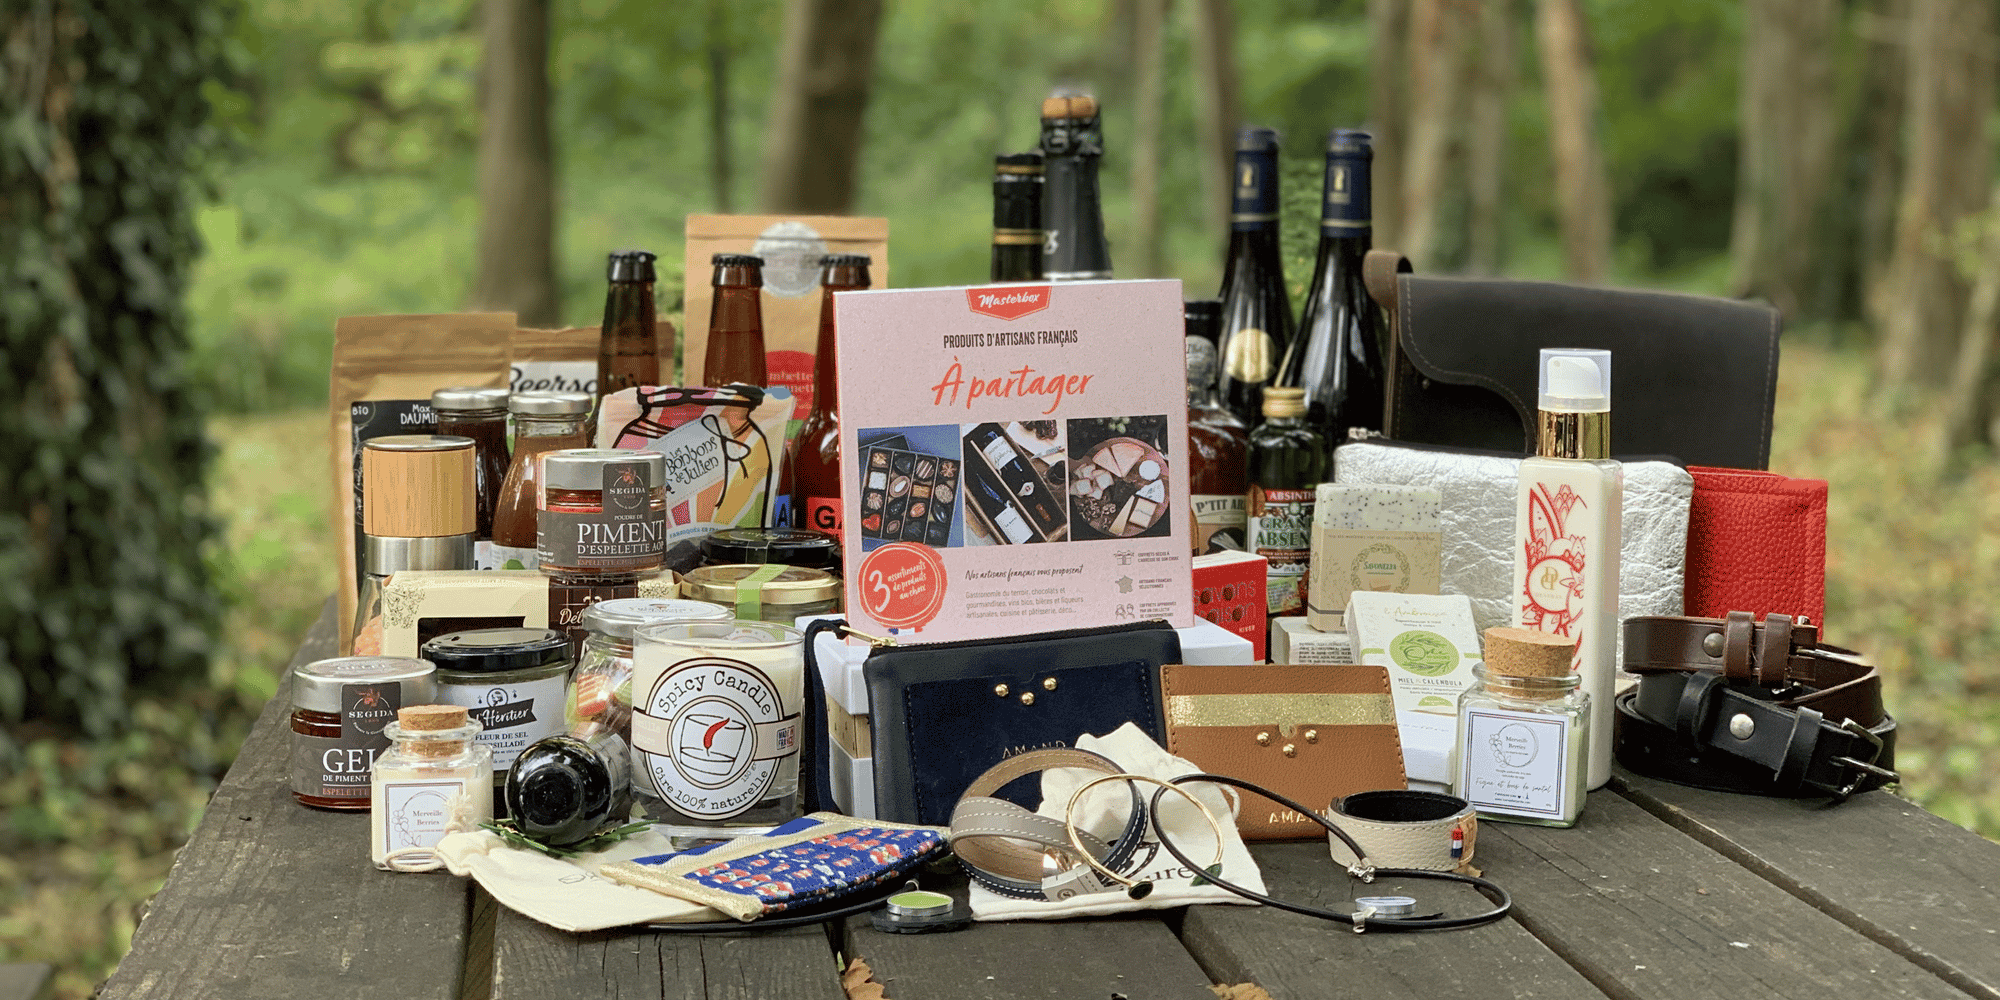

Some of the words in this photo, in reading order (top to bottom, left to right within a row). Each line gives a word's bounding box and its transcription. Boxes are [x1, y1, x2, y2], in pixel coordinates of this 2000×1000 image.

[977, 291, 1041, 309] Masterbox
[943, 333, 985, 349] PRODUITS
[987, 331, 1036, 347] D'ARTISANS
[1037, 329, 1078, 348] FRANÇAIS
[931, 355, 965, 406] À
[966, 364, 1094, 415] partager
[412, 404, 431, 413] Max
[666, 436, 719, 476] Bonbons
[674, 471, 684, 483] de
[682, 456, 719, 485] Julien
[609, 487, 646, 495] SEGIDA
[1195, 499, 1228, 513] P'TIT
[814, 505, 841, 530] G
[577, 520, 665, 544] PIMENT
[577, 543, 650, 555] D'ESPELETTE
[965, 569, 979, 580] Nos
[980, 569, 1007, 579] artisans
[1007, 567, 1036, 582] français
[1037, 568, 1051, 576] vous
[1051, 564, 1084, 577] proposent
[868, 569, 891, 612] 3
[658, 674, 707, 713] Spicy
[713, 670, 772, 716] Candle
[348, 709, 394, 719] SEGIDA
[475, 733, 500, 741] FLEUR
[515, 731, 529, 739] SEL
[335, 775, 367, 783] PIMENT
[655, 766, 674, 794] Cire
[674, 790, 708, 810] 100%
[710, 769, 768, 810] naturelle
[1269, 809, 1328, 824] AMA
